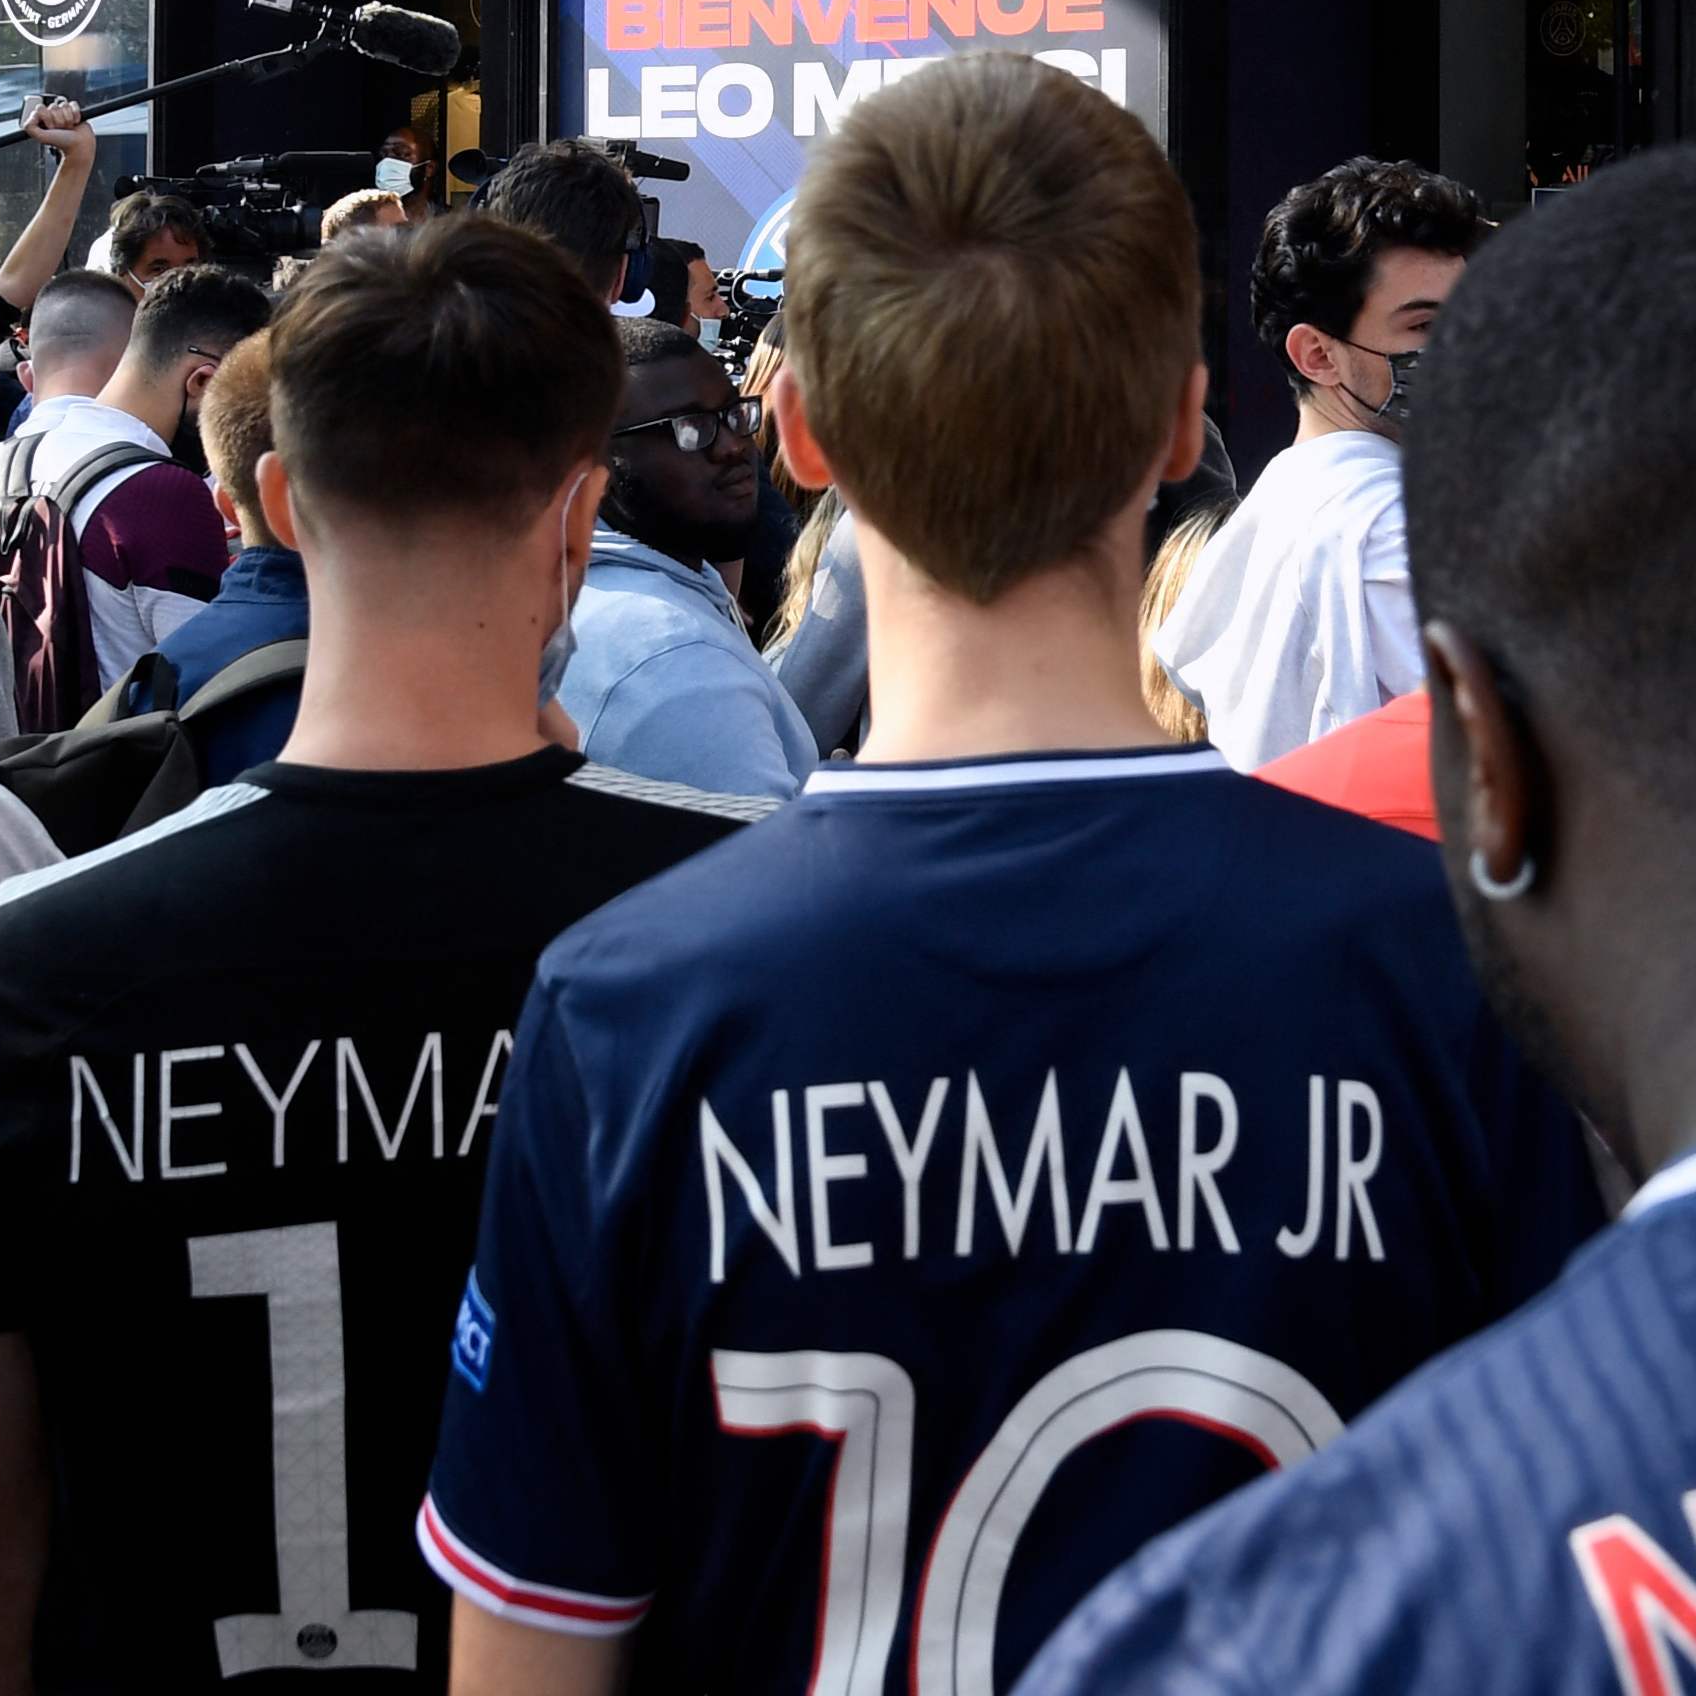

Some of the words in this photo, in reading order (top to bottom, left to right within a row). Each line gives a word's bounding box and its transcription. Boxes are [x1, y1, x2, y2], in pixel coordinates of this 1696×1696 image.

[587, 61, 774, 139] LEO
[69, 1029, 514, 1184] NEYMA
[700, 1065, 1241, 1283] NEYMAR
[1274, 1073, 1386, 1263] JR
